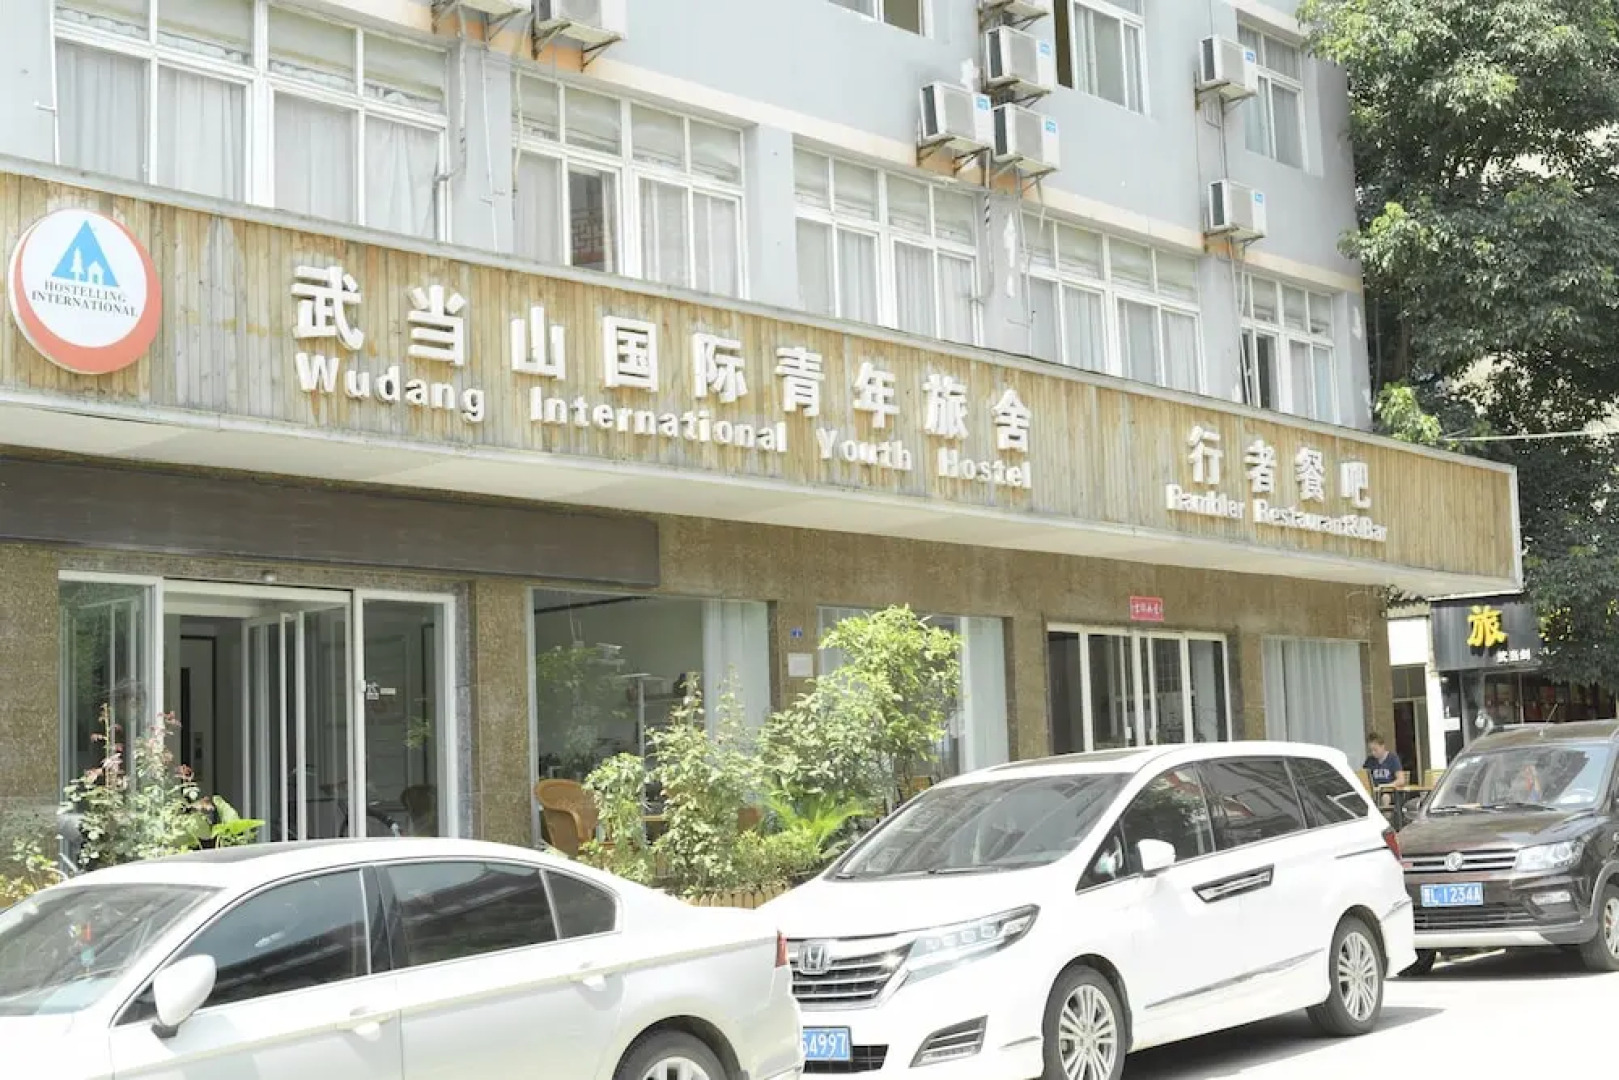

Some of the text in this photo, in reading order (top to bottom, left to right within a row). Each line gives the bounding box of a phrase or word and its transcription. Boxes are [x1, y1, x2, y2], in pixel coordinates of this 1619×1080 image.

[32, 290, 138, 317] INTERNATIONAL
[44, 279, 126, 304] HOSTELLING
[290, 264, 1033, 454] 武当山国际青年旅舍
[295, 351, 1032, 489] Wudang International Youth Hostel
[1187, 425, 1371, 509] 行者餐吧
[1467, 605, 1508, 647] 旅
